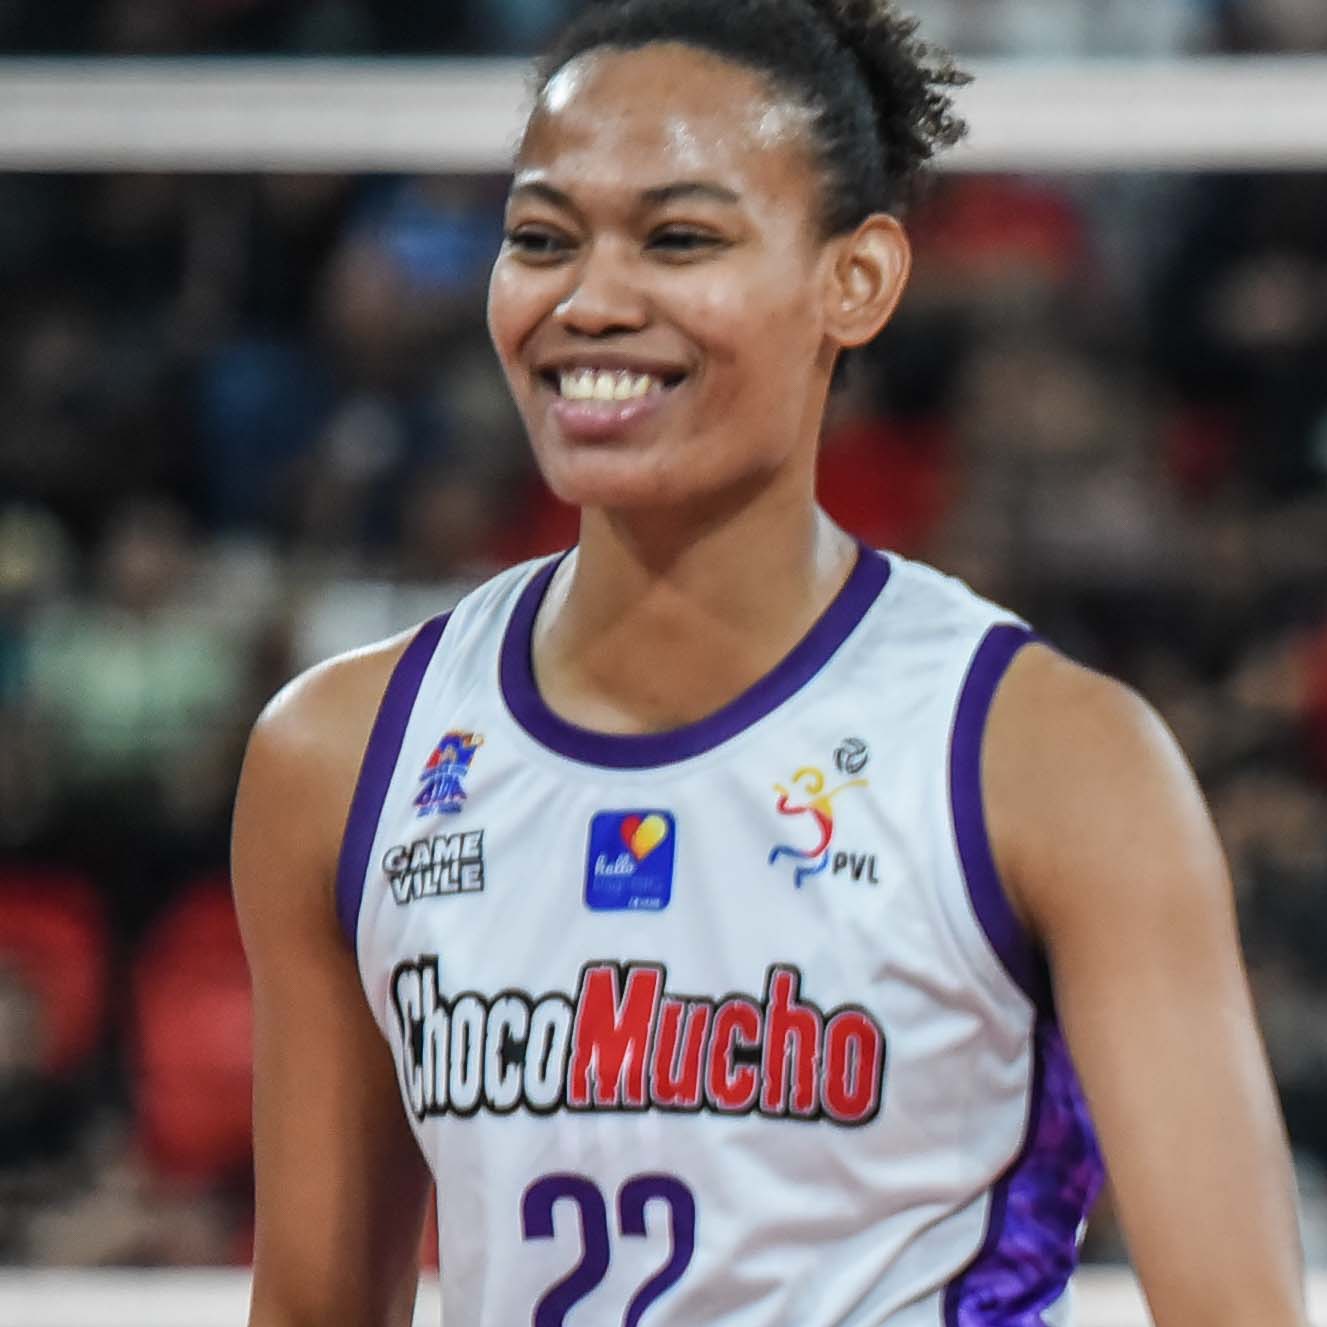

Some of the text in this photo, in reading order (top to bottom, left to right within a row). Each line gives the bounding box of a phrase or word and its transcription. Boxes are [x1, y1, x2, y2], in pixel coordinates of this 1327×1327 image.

[382, 829, 484, 876] GAME
[832, 851, 880, 884] PVL
[390, 861, 484, 905] VILLE
